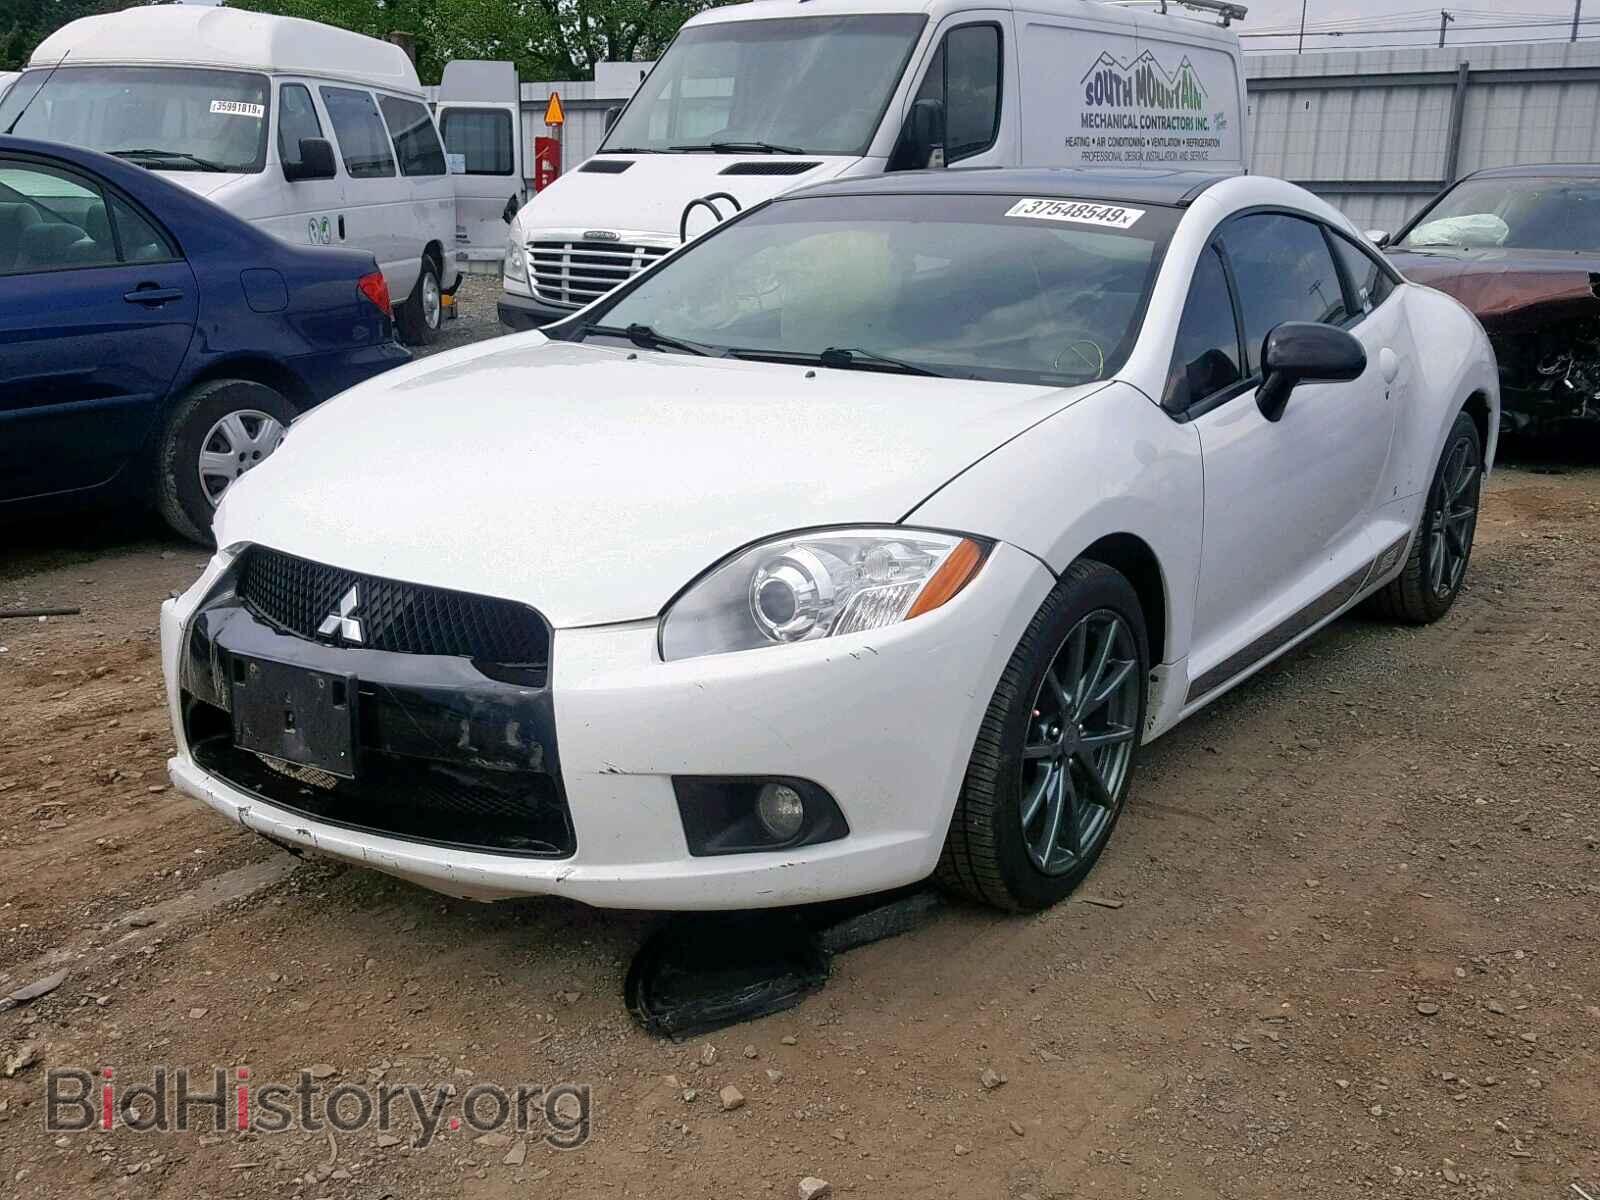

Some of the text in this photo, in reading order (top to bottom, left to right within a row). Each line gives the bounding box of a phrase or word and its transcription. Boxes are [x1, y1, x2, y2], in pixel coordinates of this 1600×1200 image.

[1085, 63, 1202, 110] SOUTH MOUNTAIN
[1081, 112, 1138, 129] MECHANICAL
[1140, 114, 1194, 131] CONTRACTORS
[1195, 117, 1210, 131] INC.
[1065, 136, 1220, 148] HEATING AIR CONDITIONING VENTILATION REFRIGERATION
[1081, 151, 1122, 161] PROFESSIONAL
